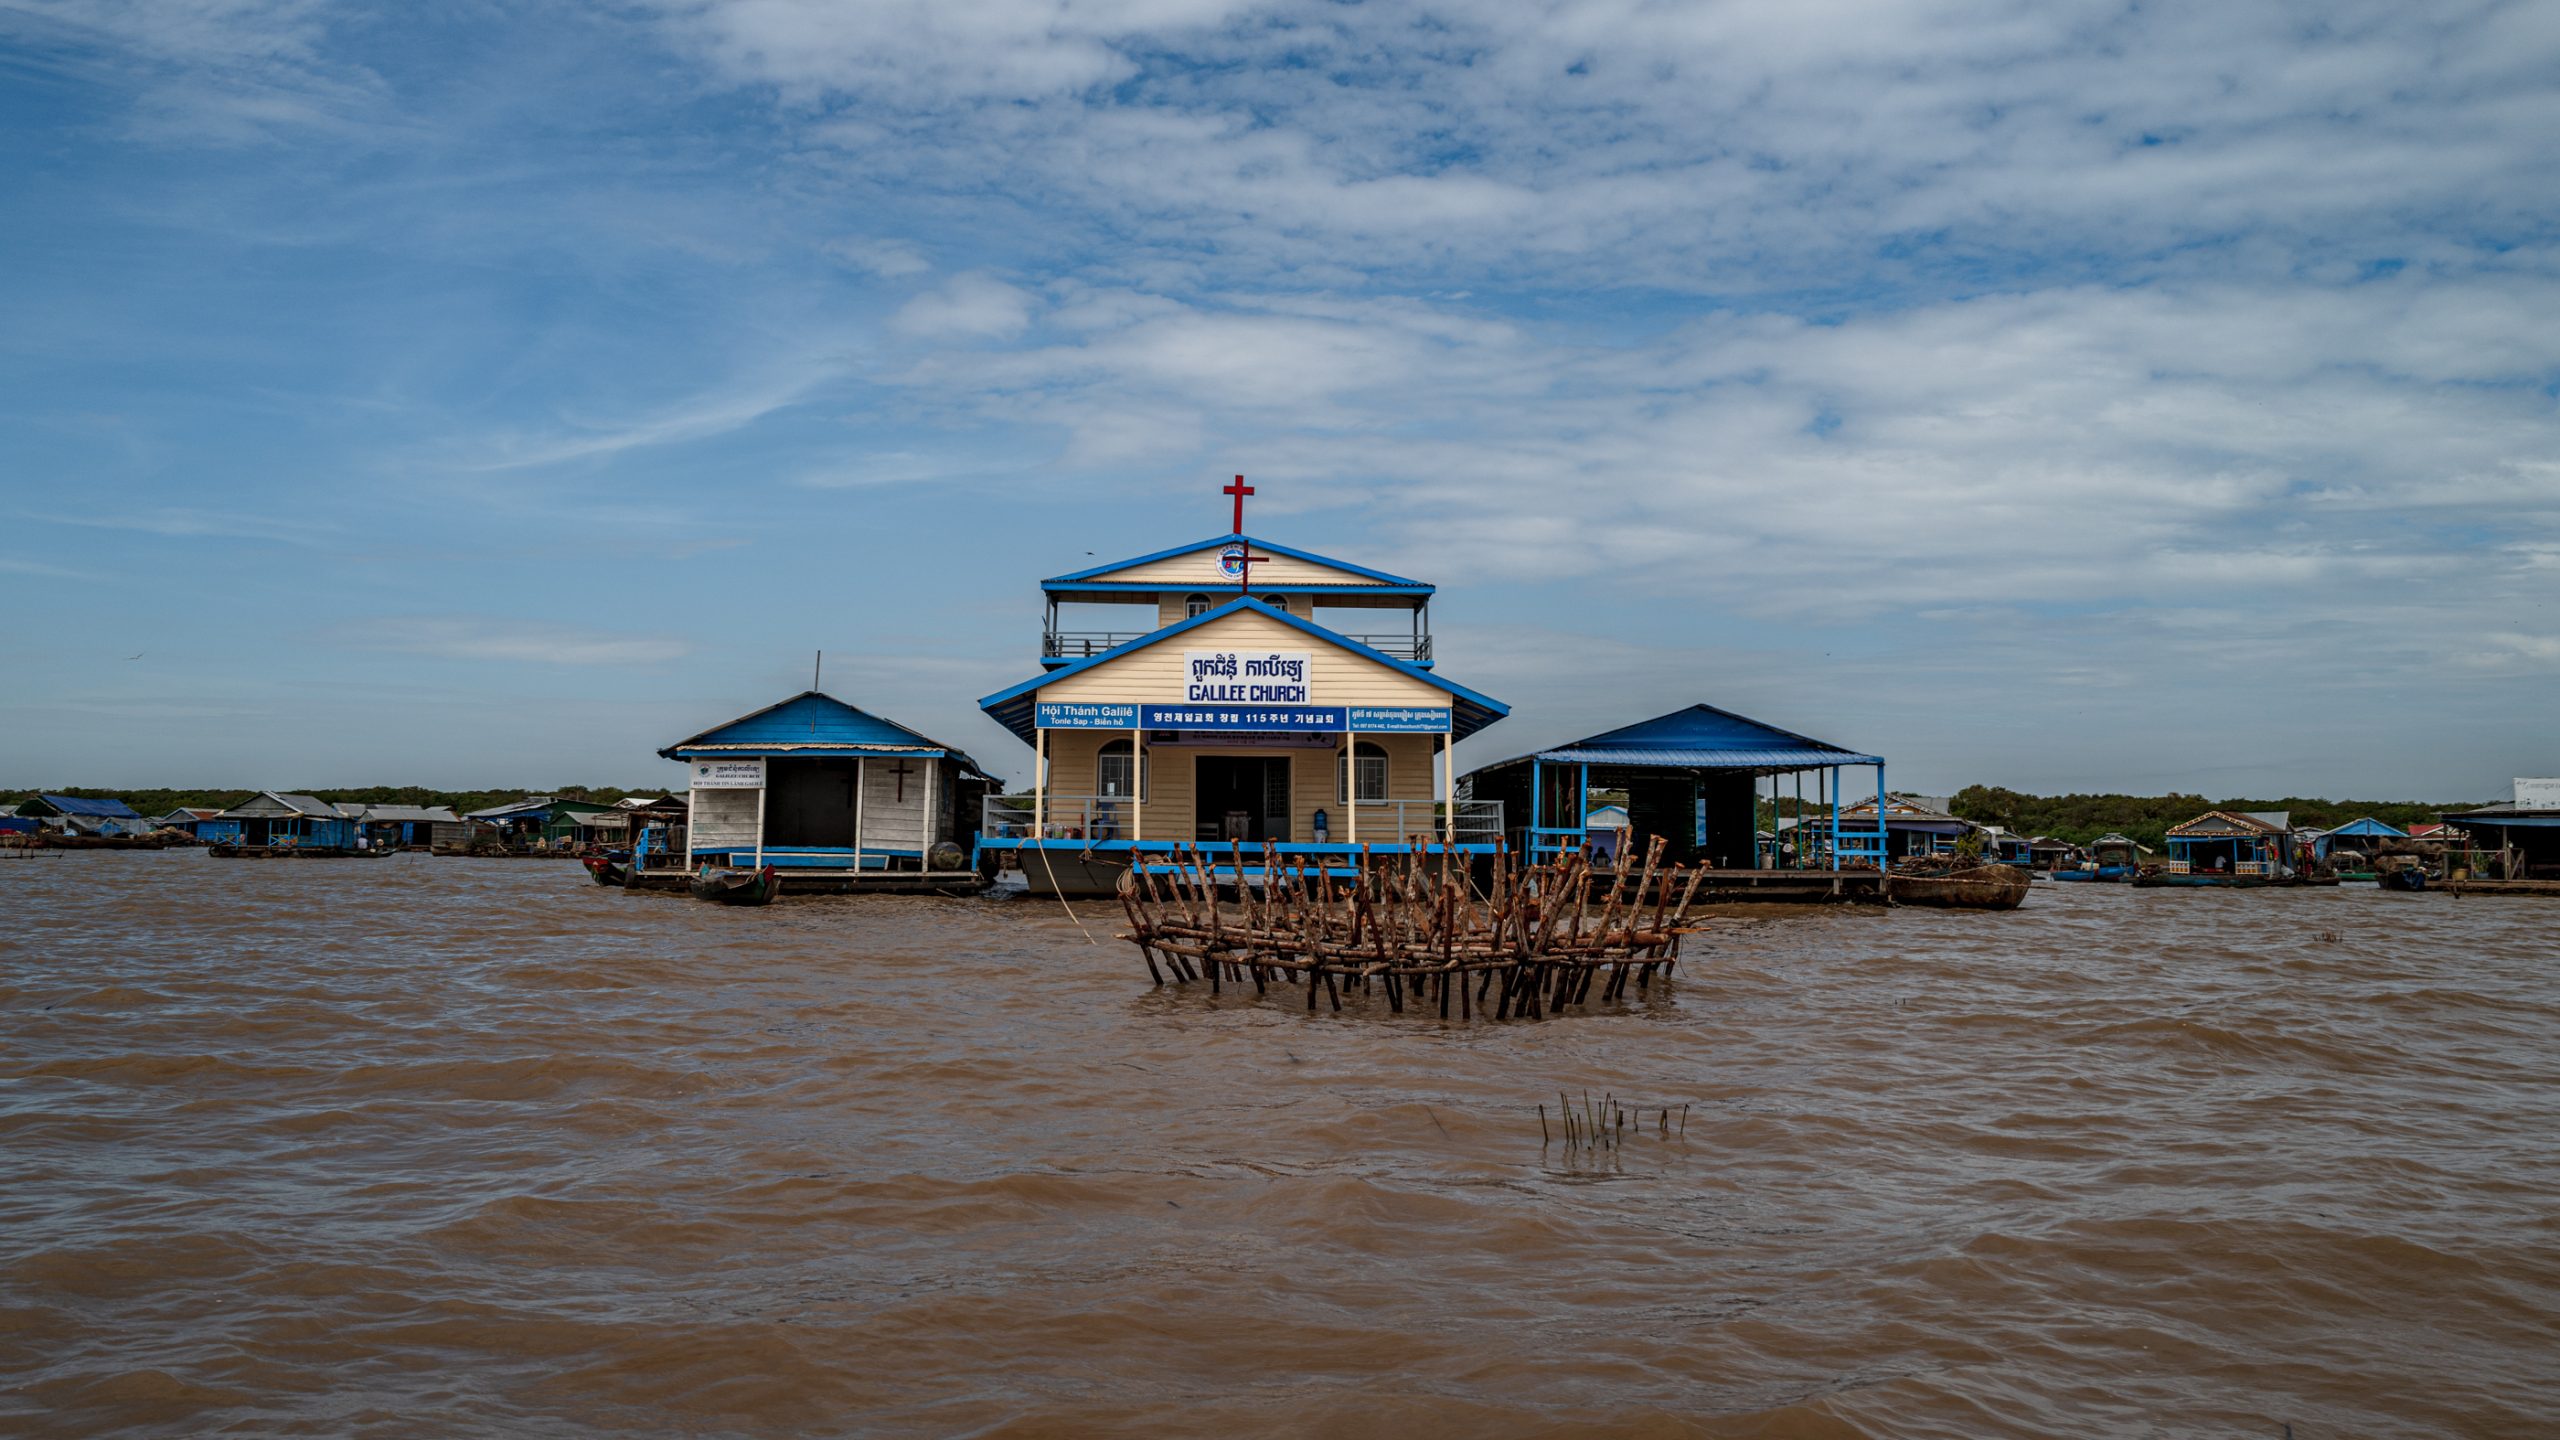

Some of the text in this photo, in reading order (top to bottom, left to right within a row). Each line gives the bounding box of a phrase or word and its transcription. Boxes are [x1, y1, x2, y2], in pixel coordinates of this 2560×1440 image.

[1189, 684, 1306, 702] GALILEE CHURCH
[1041, 705, 1133, 717] Hội Thánh Galilê
[1051, 717, 1072, 725] Tonle
[1073, 717, 1088, 726] Sap
[1295, 714, 1334, 724] 기념교회
